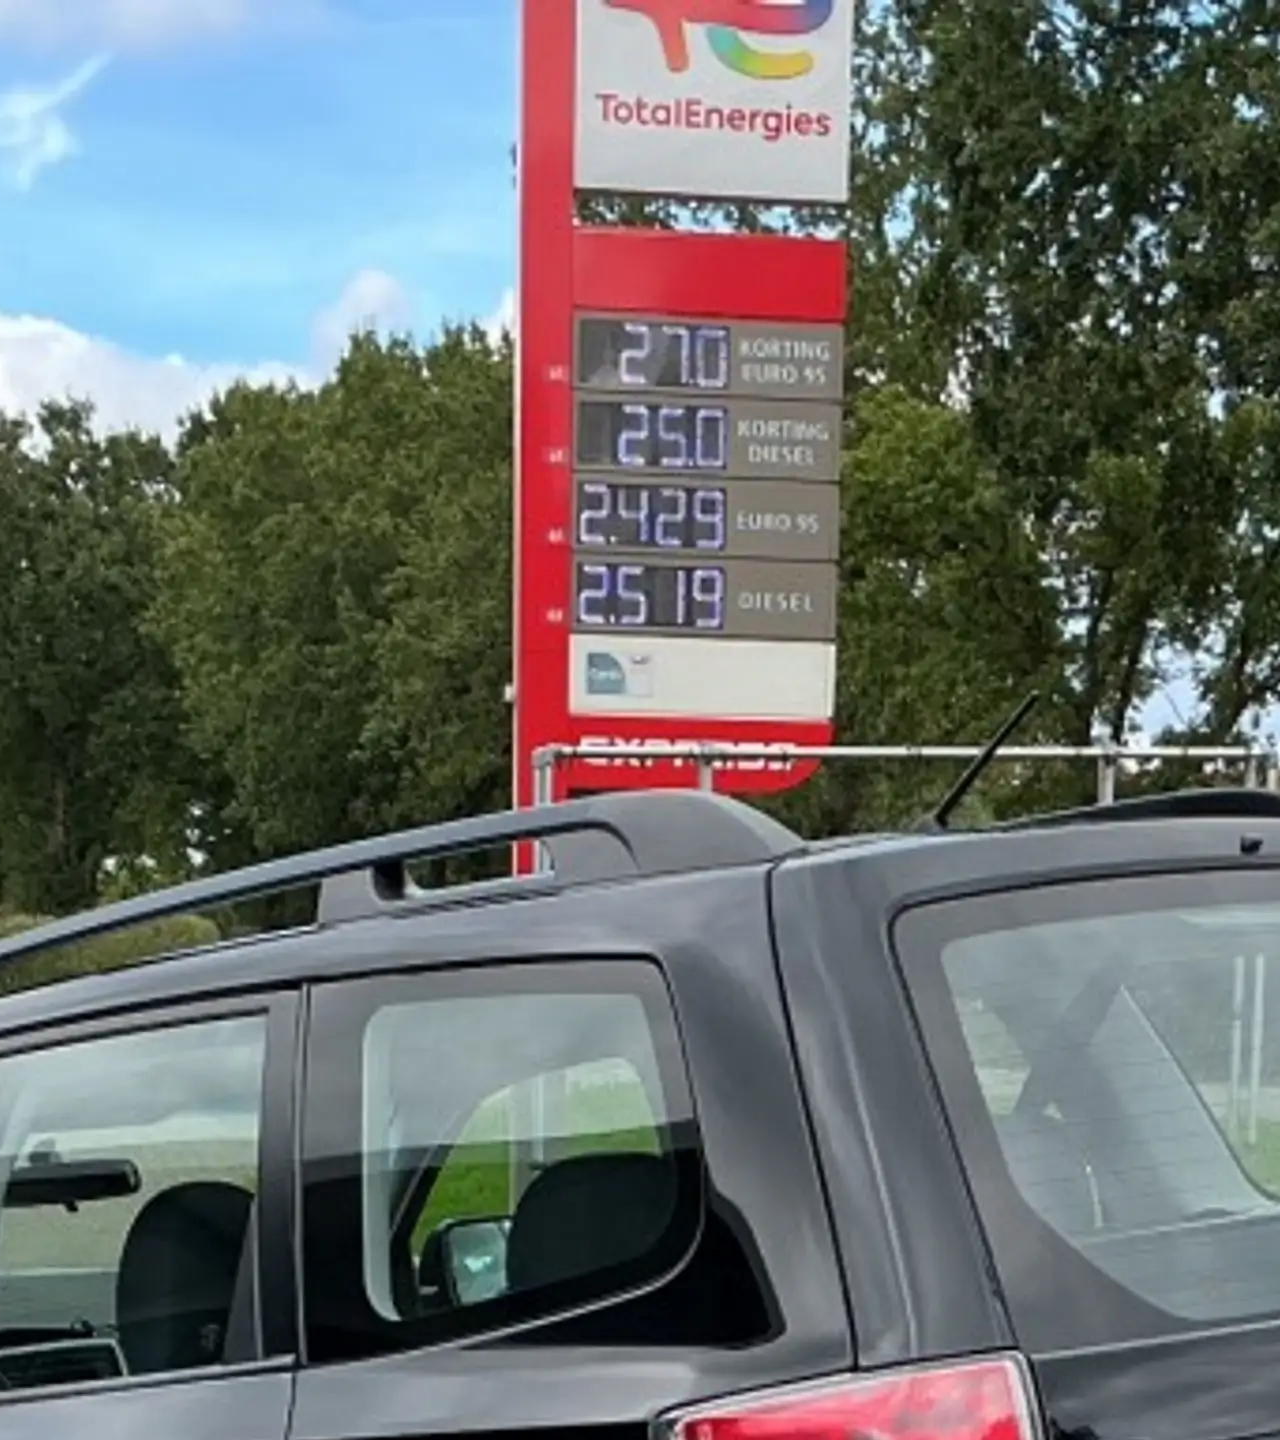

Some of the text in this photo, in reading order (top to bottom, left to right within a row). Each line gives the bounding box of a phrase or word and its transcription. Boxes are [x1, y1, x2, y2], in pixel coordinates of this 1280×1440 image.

[596, 92, 832, 141] TotalEnergies
[738, 337, 831, 361] KORTING
[740, 362, 798, 384] EURO
[736, 419, 829, 441] KORTING
[747, 446, 815, 467] DIESEL
[579, 483, 725, 549] 2.429
[736, 512, 791, 533] EURO
[737, 592, 814, 613] DIESEL
